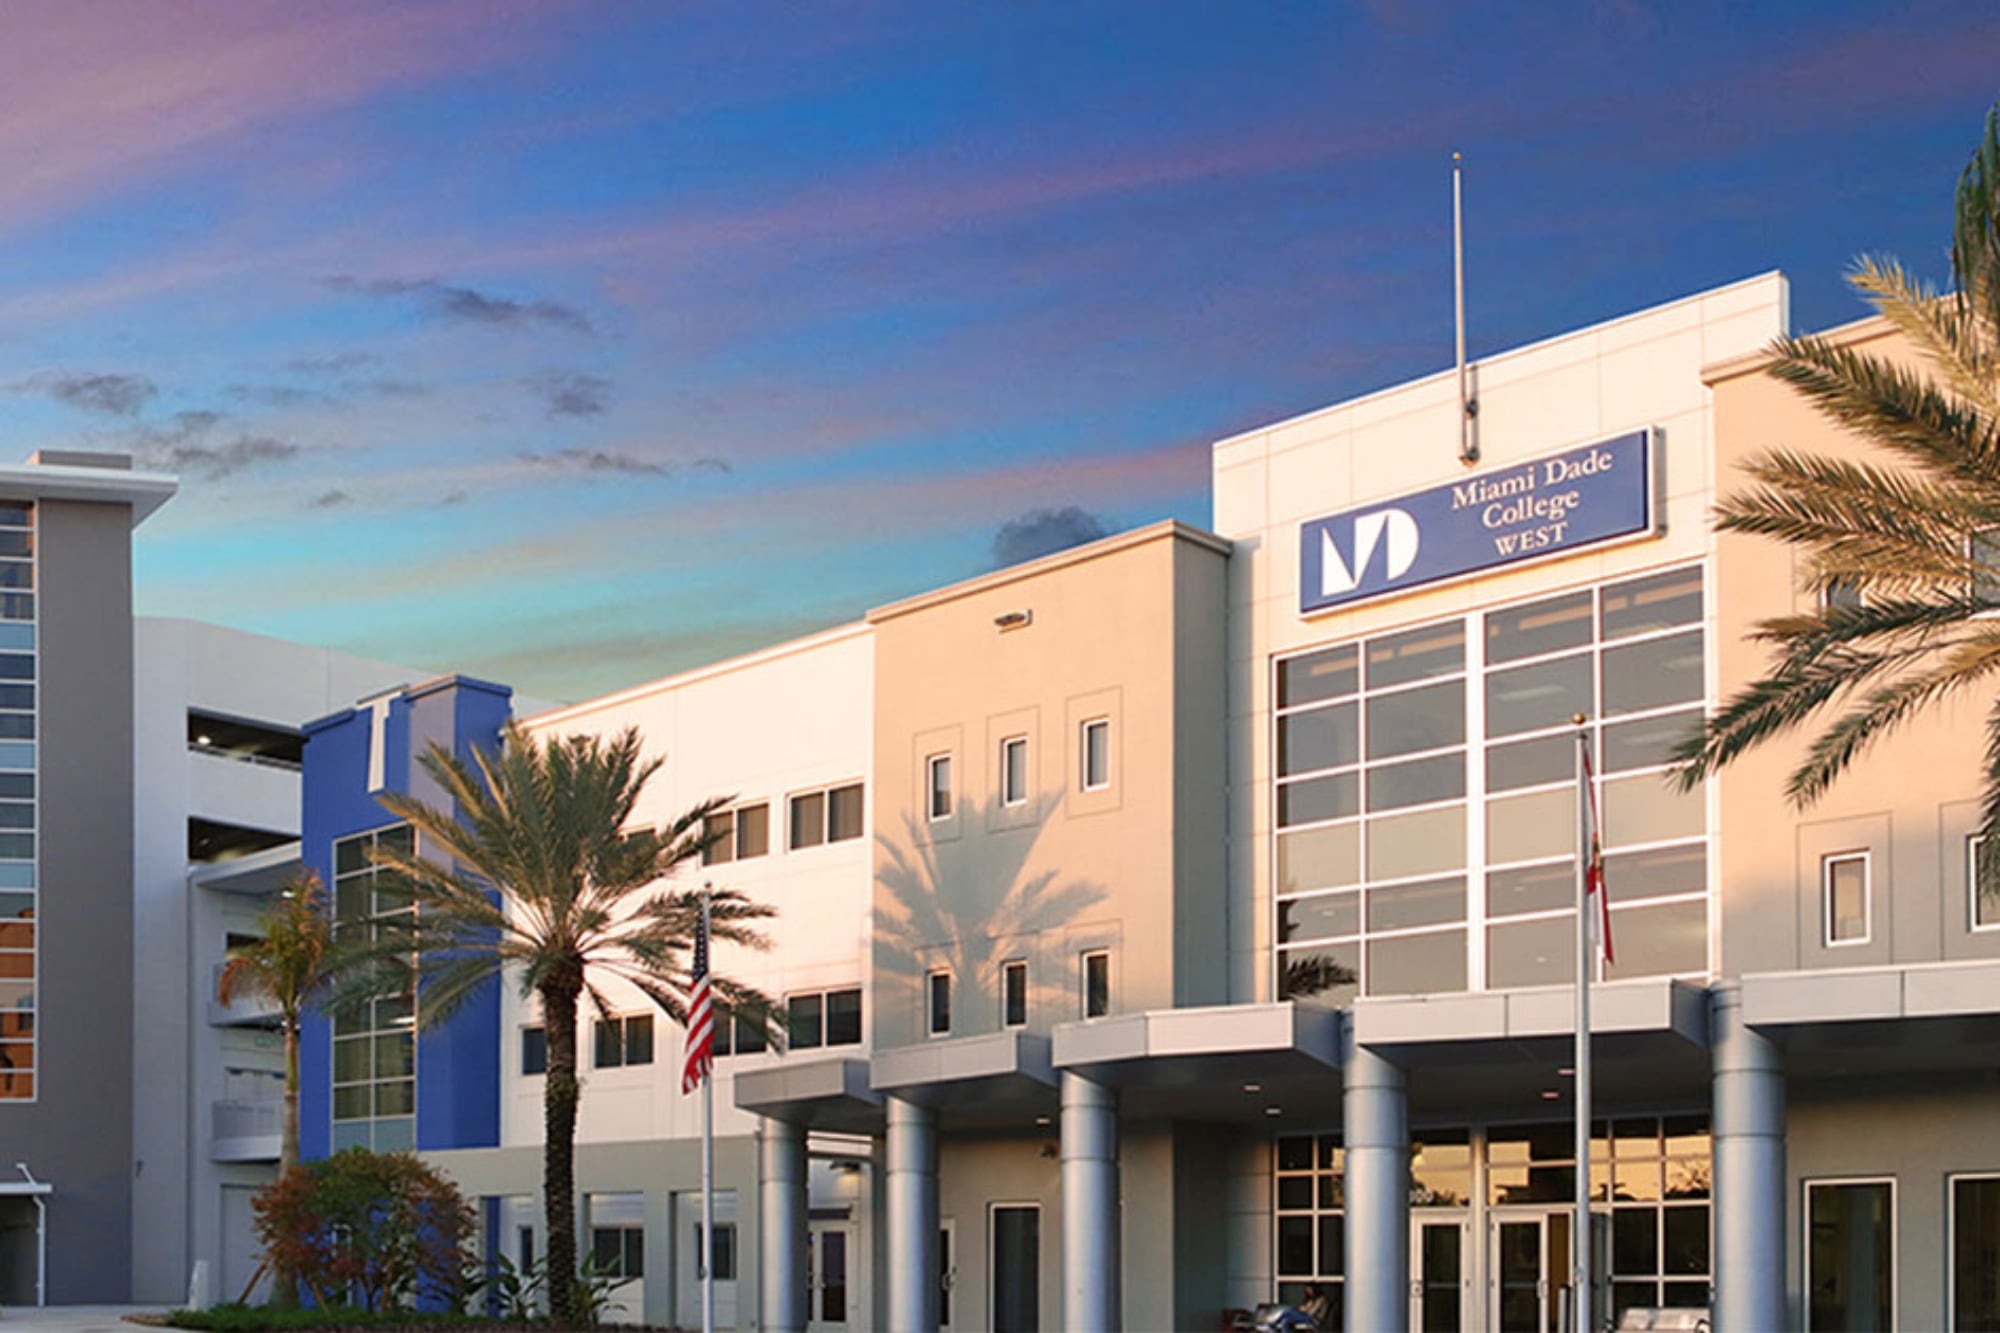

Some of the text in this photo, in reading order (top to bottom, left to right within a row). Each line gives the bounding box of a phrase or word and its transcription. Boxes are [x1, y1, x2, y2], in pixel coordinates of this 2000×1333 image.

[1452, 449, 1613, 511] Miami Dade
[1482, 490, 1580, 529] College
[1494, 521, 1569, 557] WEST
